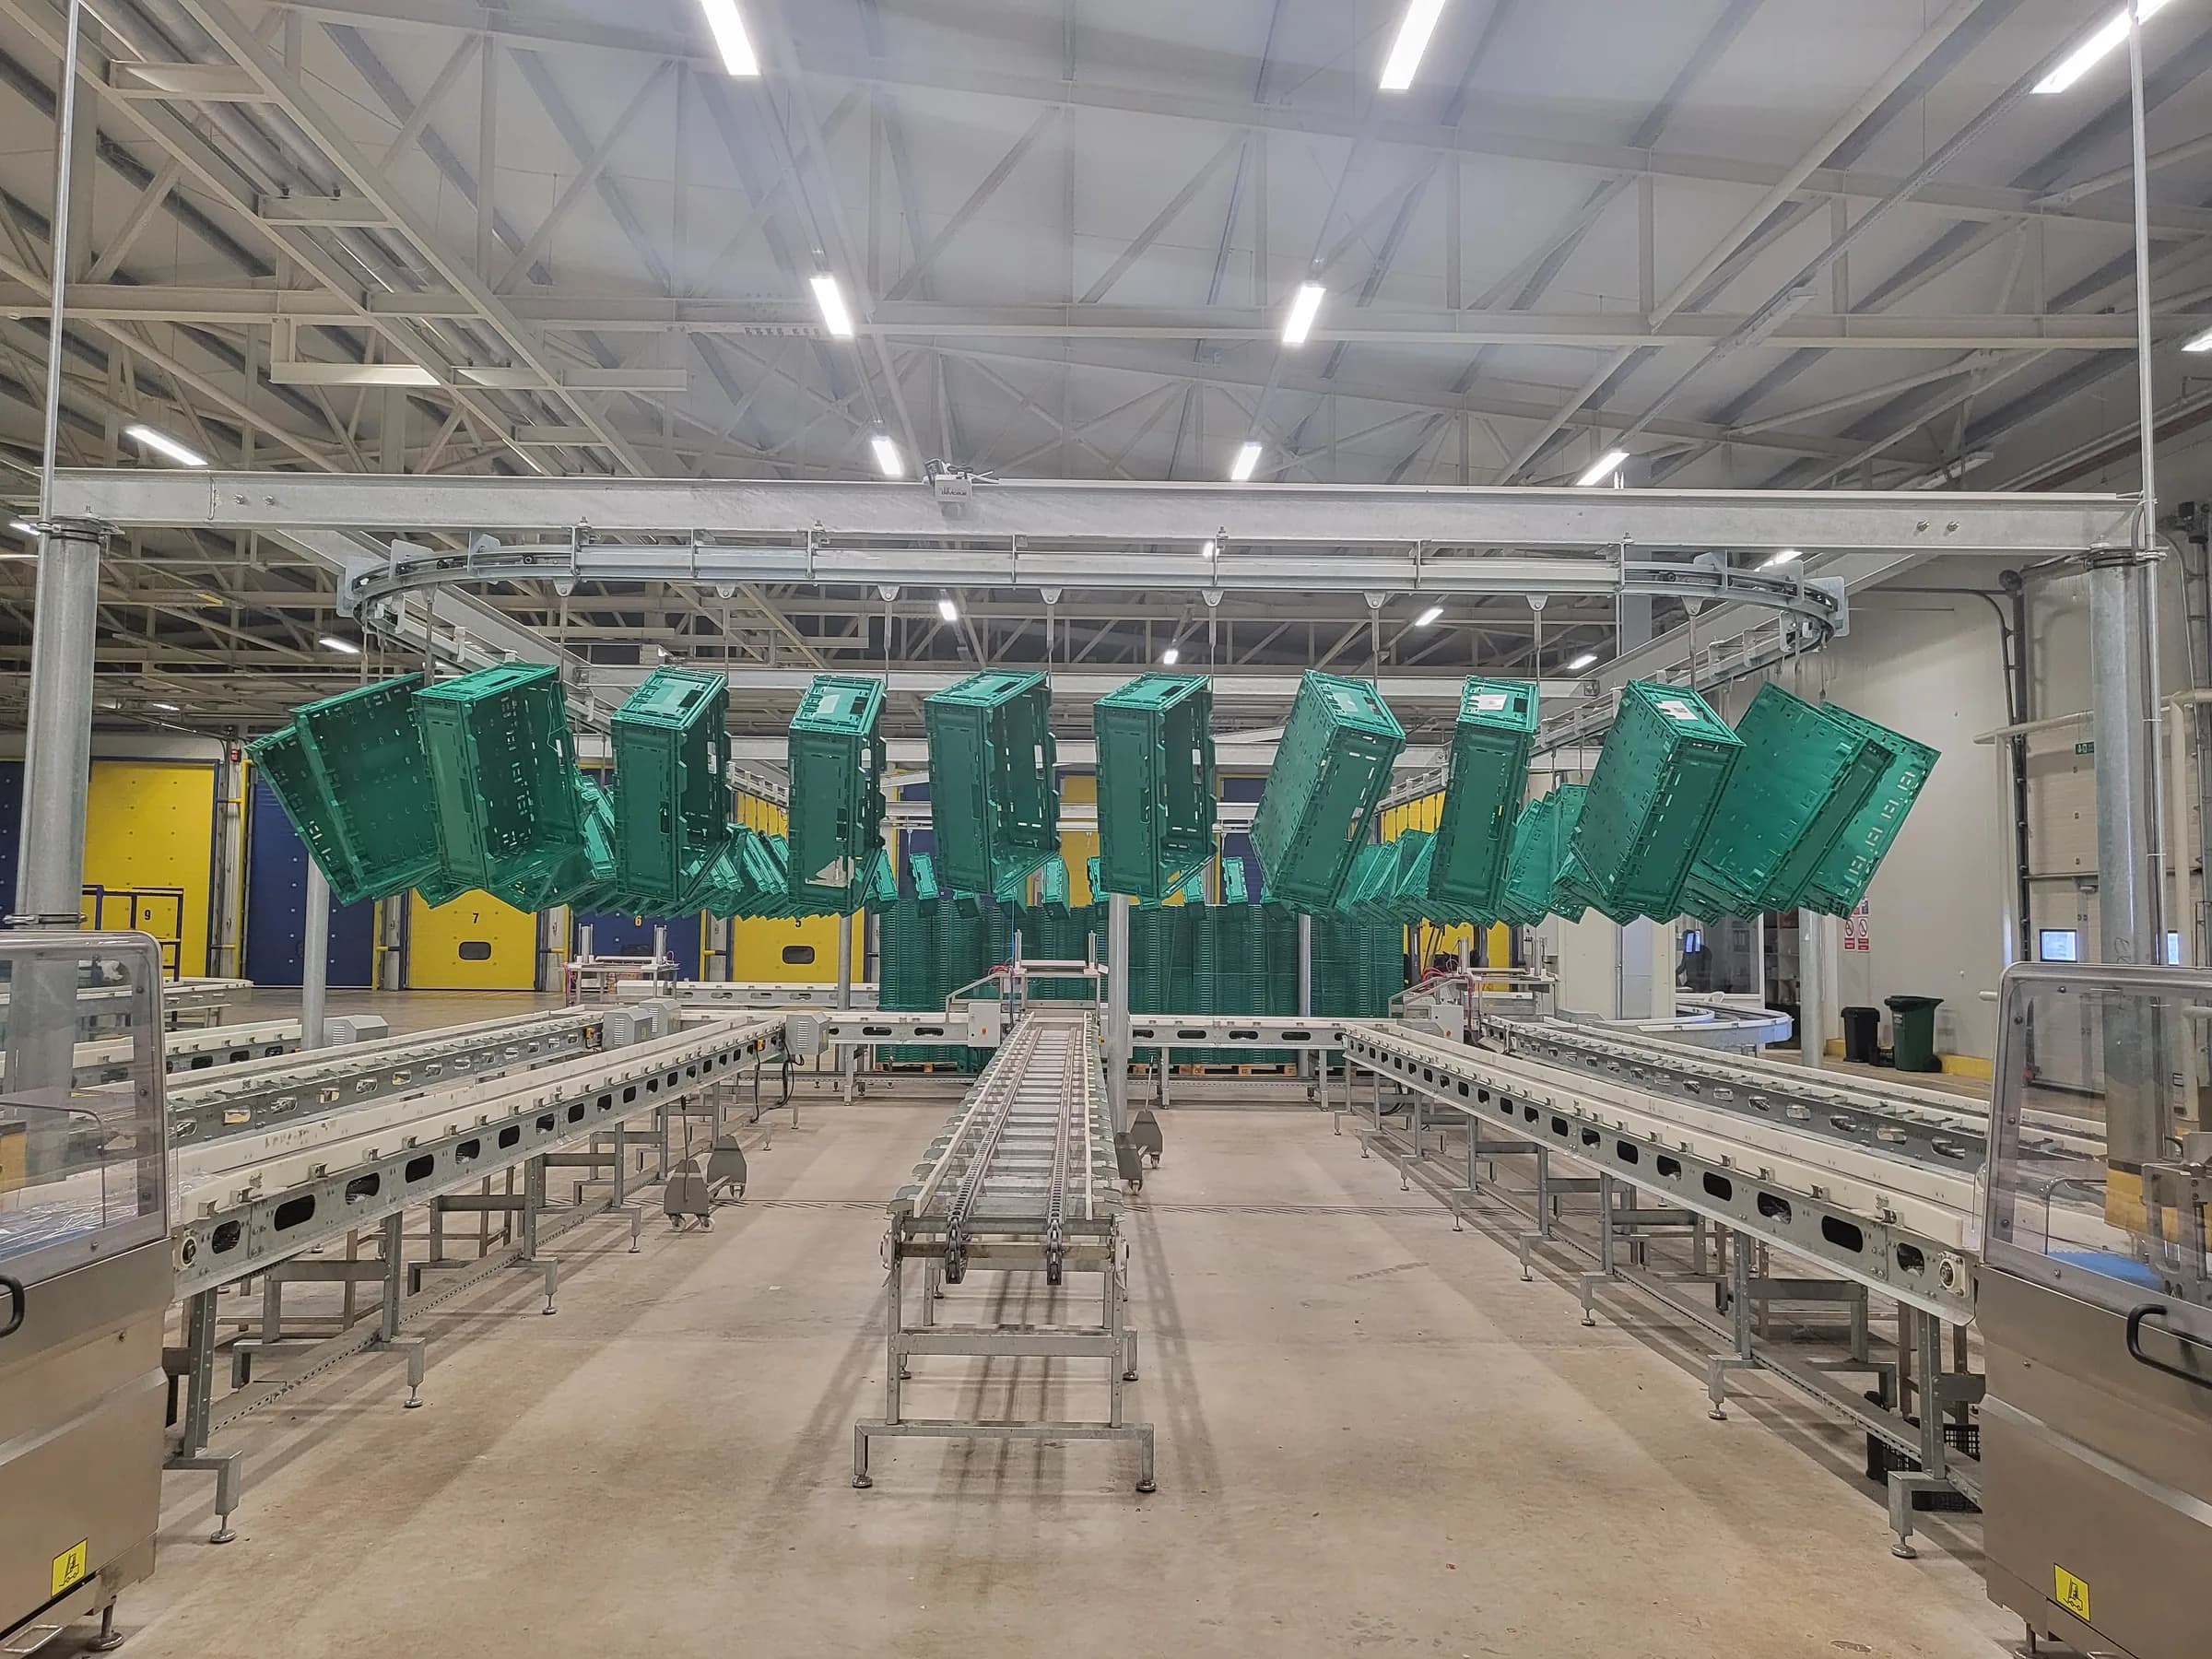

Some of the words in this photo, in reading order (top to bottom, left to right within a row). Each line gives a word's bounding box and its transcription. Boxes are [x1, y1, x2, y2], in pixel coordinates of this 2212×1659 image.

[144, 909, 151, 921] 9
[472, 912, 479, 924] 7
[635, 915, 642, 926] 6
